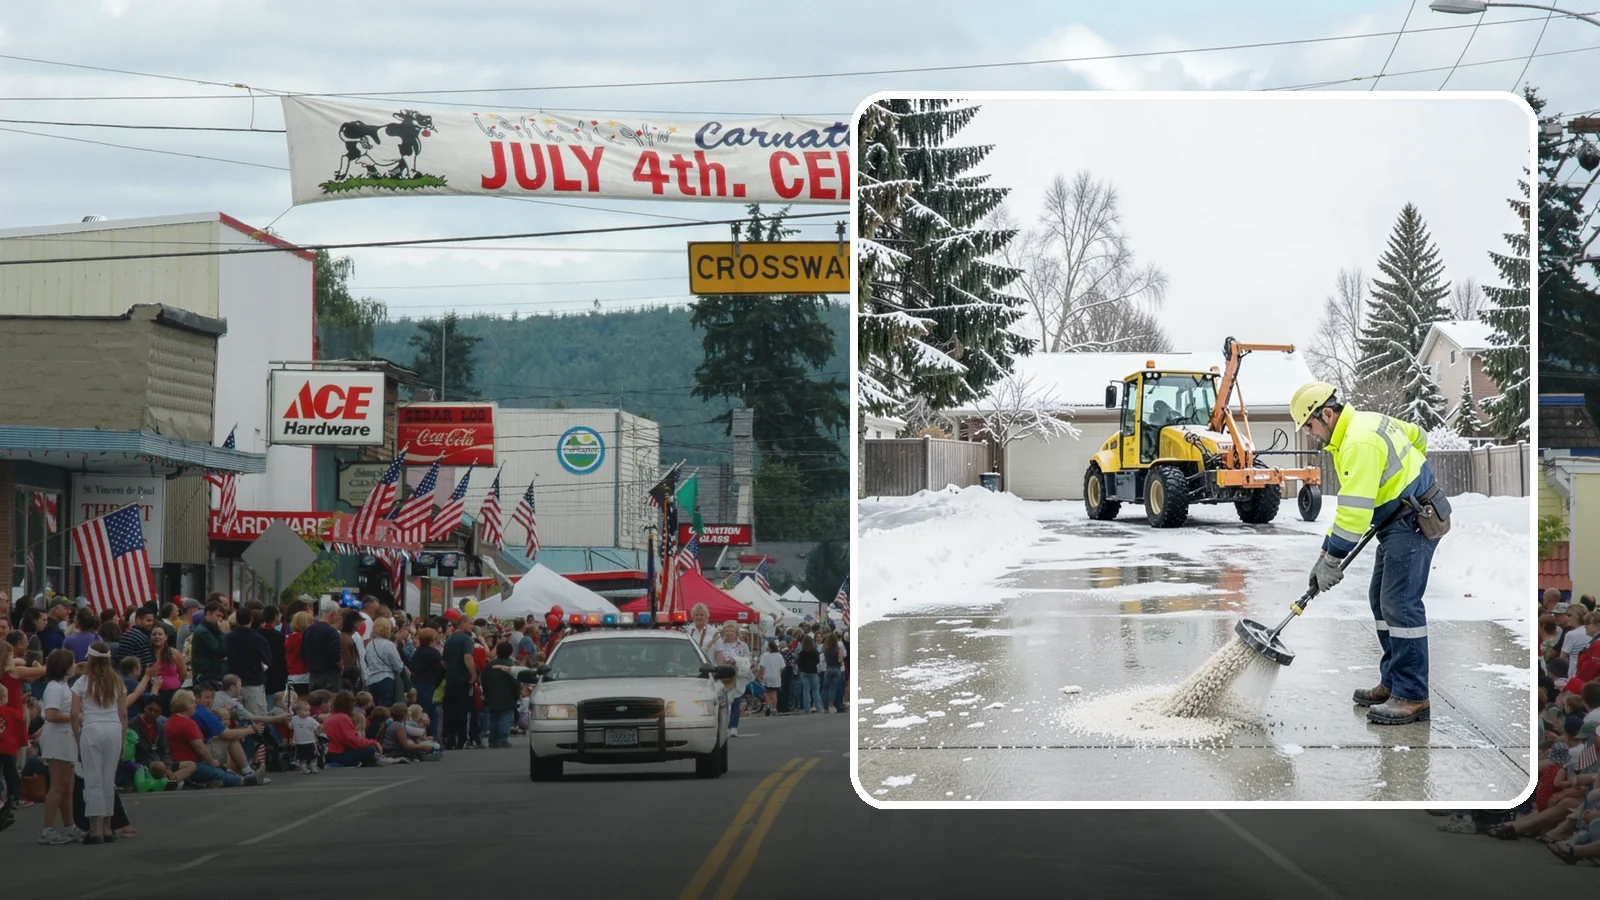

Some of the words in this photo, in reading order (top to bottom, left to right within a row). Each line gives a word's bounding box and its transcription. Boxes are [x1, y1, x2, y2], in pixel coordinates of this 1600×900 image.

[695, 121, 850, 150] Carnat
[481, 141, 605, 193] JULY
[632, 150, 747, 198] 4th.
[697, 254, 850, 280] CROSSWA
[282, 380, 373, 420] ACE
[406, 409, 452, 422] CEDAR
[461, 409, 485, 421] LOG
[283, 421, 371, 437] Hardware
[416, 428, 477, 447] Coca-Cola
[96, 485, 124, 494] Vincent
[126, 486, 135, 494] de
[137, 486, 155, 495] Paul
[688, 526, 741, 535] CRNATION
[699, 535, 730, 543] GLASS
